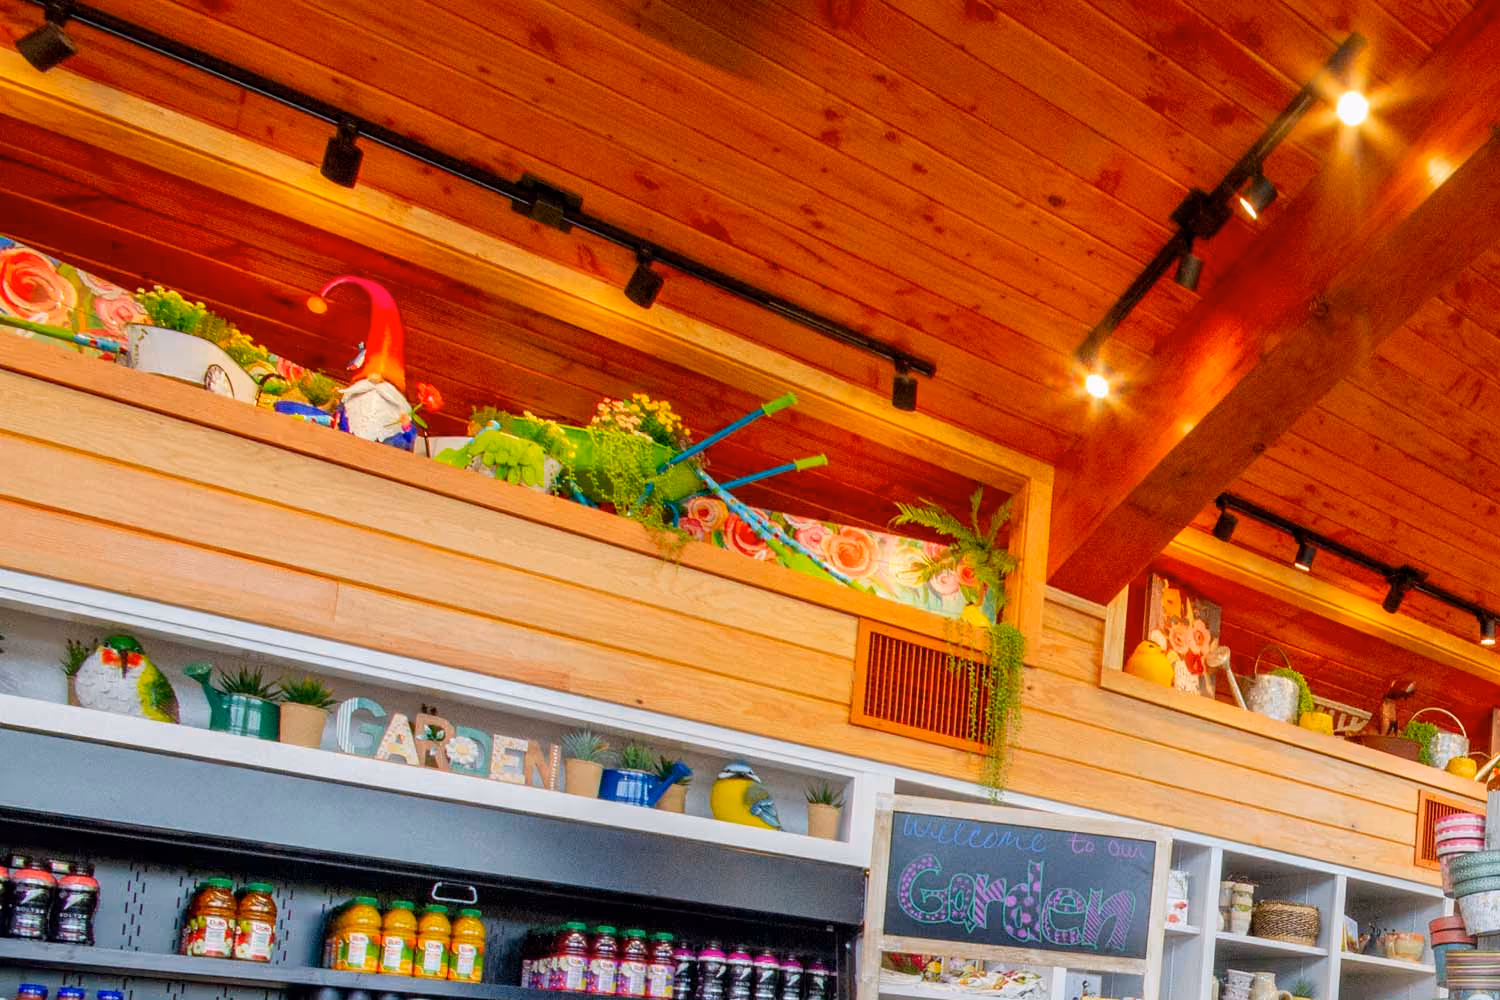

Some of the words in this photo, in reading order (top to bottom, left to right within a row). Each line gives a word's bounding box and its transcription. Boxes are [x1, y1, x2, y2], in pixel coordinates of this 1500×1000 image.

[337, 697, 562, 792] GARDEN
[1068, 833, 1095, 854] to
[1108, 840, 1146, 858] our
[898, 853, 1136, 951] Garden
